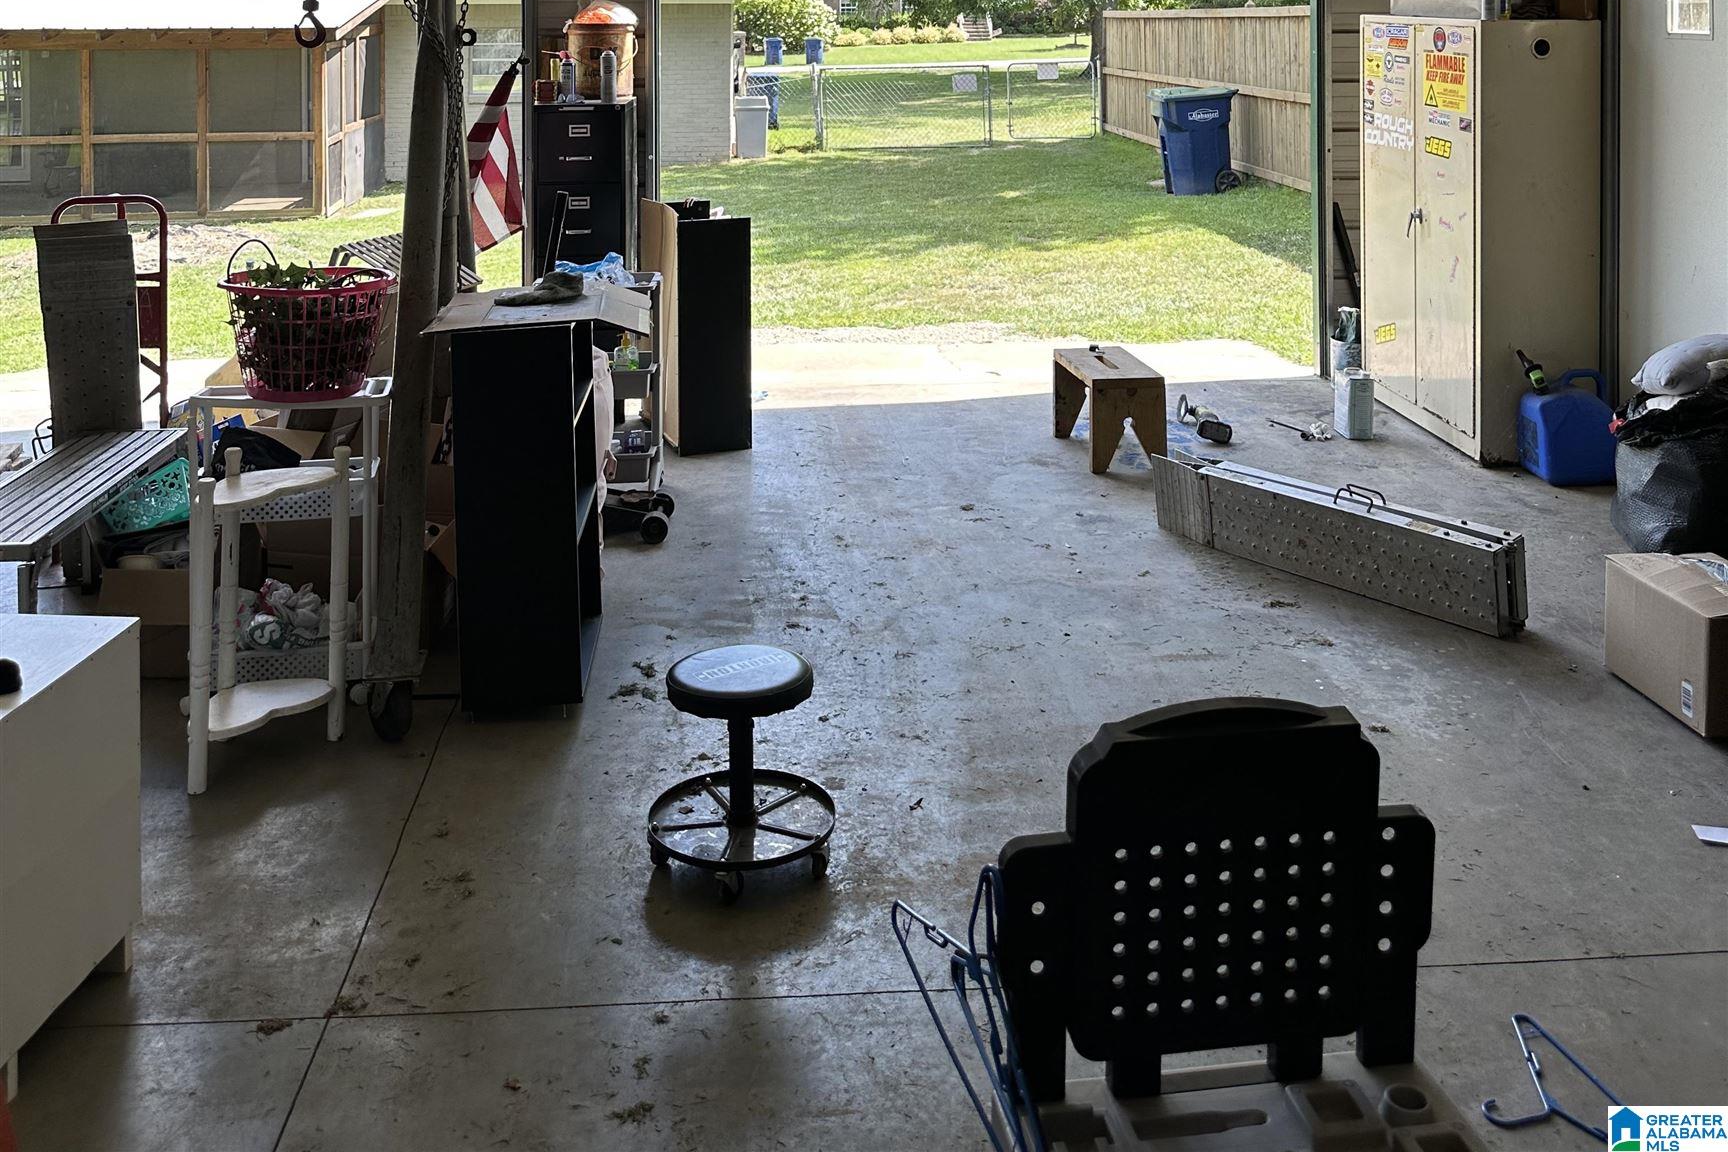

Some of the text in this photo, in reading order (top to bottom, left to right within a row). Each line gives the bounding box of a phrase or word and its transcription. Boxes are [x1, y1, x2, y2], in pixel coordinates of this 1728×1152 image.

[1425, 53, 1465, 73] FLAMMABLE
[1426, 70, 1465, 85] KEEP FIRE AWAY
[1374, 112, 1413, 135] ROUGH
[1365, 128, 1414, 152] COUNTRY
[1425, 136, 1452, 159] JEGS
